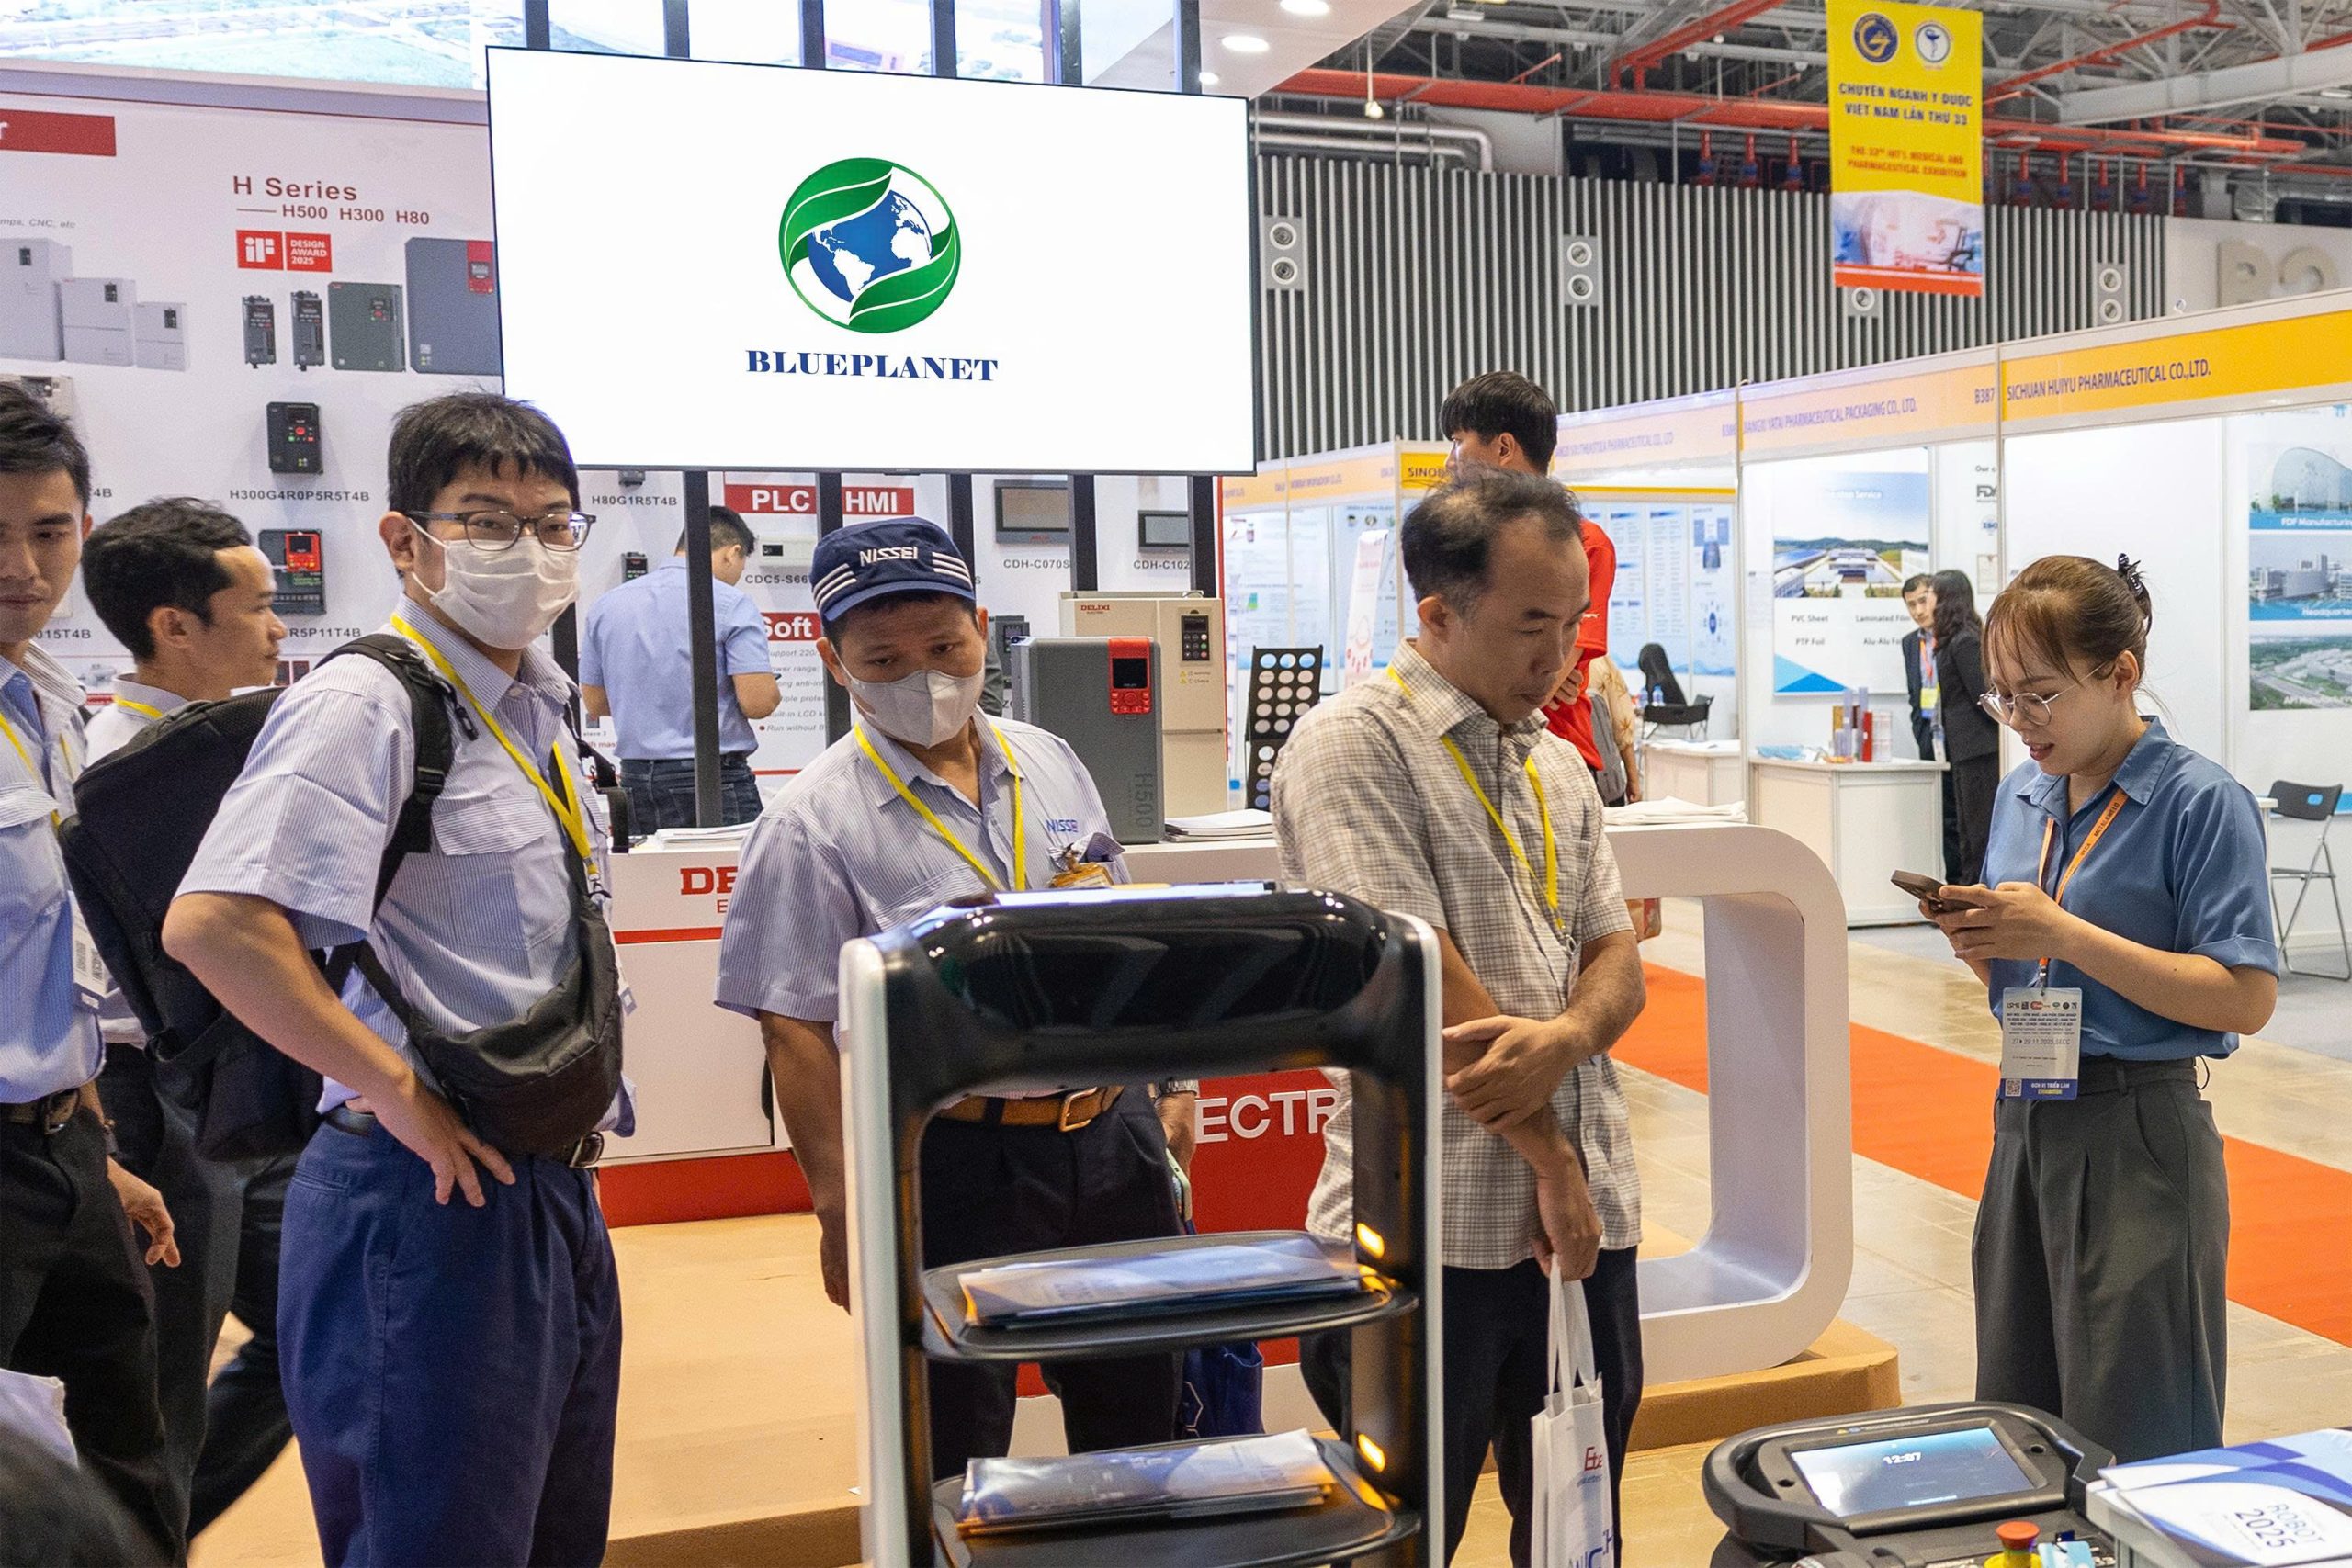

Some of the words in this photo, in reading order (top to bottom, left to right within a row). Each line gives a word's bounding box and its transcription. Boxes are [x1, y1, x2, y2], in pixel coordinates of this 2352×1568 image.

[1873, 106, 1899, 118] NAM
[232, 175, 252, 195] H
[265, 177, 358, 201] Series
[282, 204, 328, 220] H500
[339, 208, 384, 222] H300
[396, 210, 430, 225] H80
[290, 239, 326, 249] DESIGN
[290, 247, 327, 258] AWARD
[291, 256, 315, 265] 2025
[745, 349, 998, 381] BLUEPLANET
[2007, 380, 2047, 401] SICHUAN
[2048, 377, 2077, 395] HUIYU
[2078, 365, 2167, 391] PHARMACEUTICAL
[1974, 388, 1995, 404] B387
[230, 490, 370, 502] H300G4R0P5R5T4B
[591, 495, 678, 506] H80G1R5T4B
[752, 489, 810, 512] PLC
[845, 491, 898, 513] HMI
[859, 546, 919, 567] NISSEI
[1791, 615, 1805, 623] PVC
[1807, 615, 1829, 623] Sheet
[1855, 615, 1894, 623] Laminated
[2234, 1507, 2297, 1548] 2025
